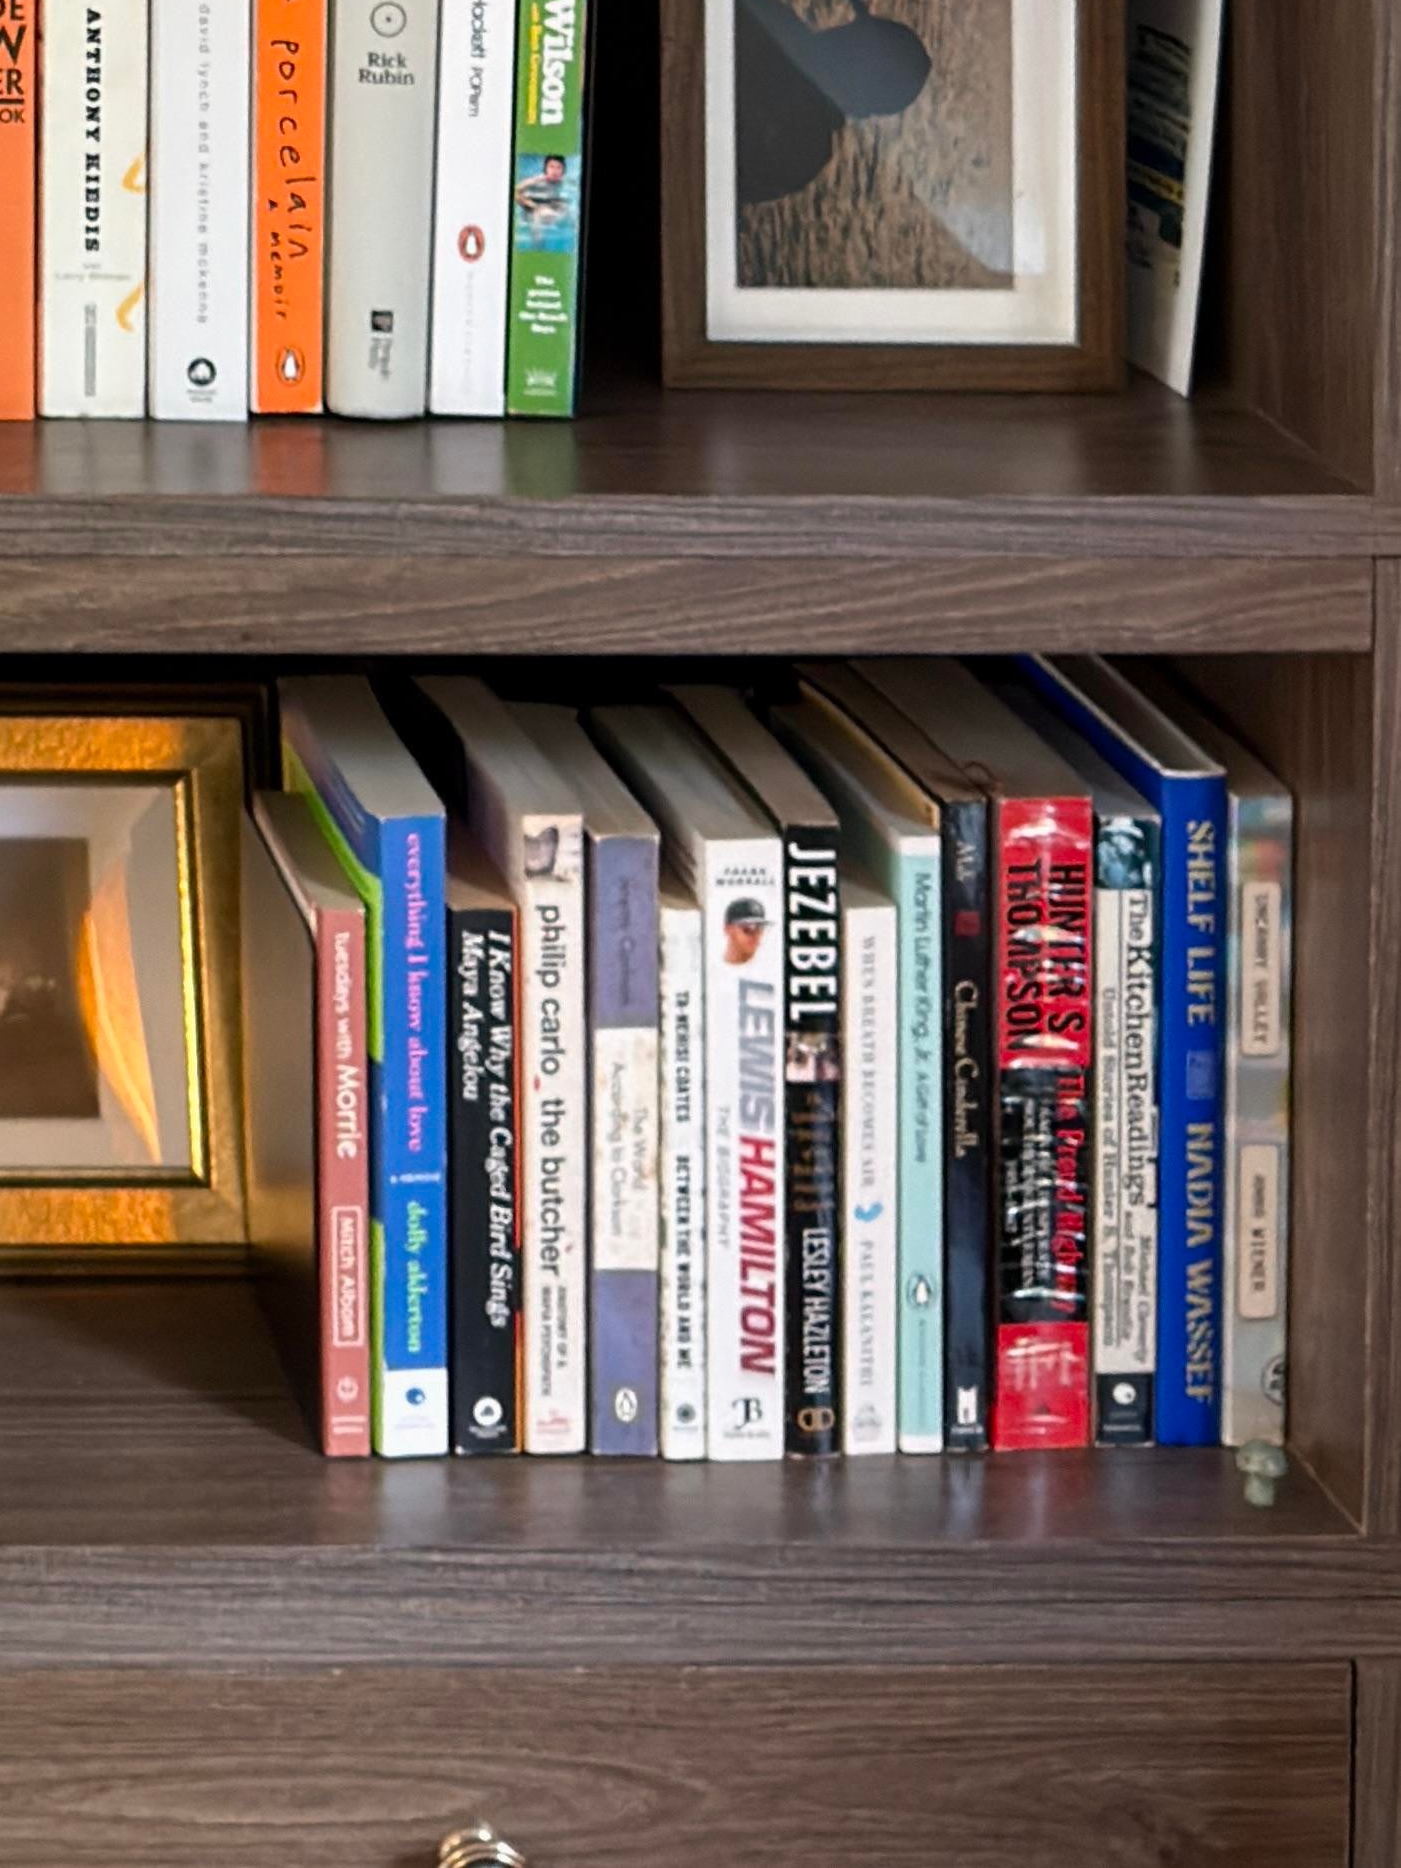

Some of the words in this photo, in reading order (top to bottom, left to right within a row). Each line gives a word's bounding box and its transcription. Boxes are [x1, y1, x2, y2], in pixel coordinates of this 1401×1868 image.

[83, 8, 103, 143] ANTHONY
[358, 68, 414, 86] Rubin
[367, 52, 406, 69] Rick
[84, 150, 100, 253] KIEDIS
[1185, 820, 1215, 929] SHELF
[536, 904, 564, 990] phillip
[788, 842, 837, 1022] JEZEBEL
[536, 996, 560, 1076] carlo
[1187, 945, 1216, 1028] LIFE
[737, 978, 776, 1133] LEWIS
[541, 1095, 565, 1148] the
[539, 1155, 564, 1278] butcher
[738, 1136, 778, 1377] HAMILTON
